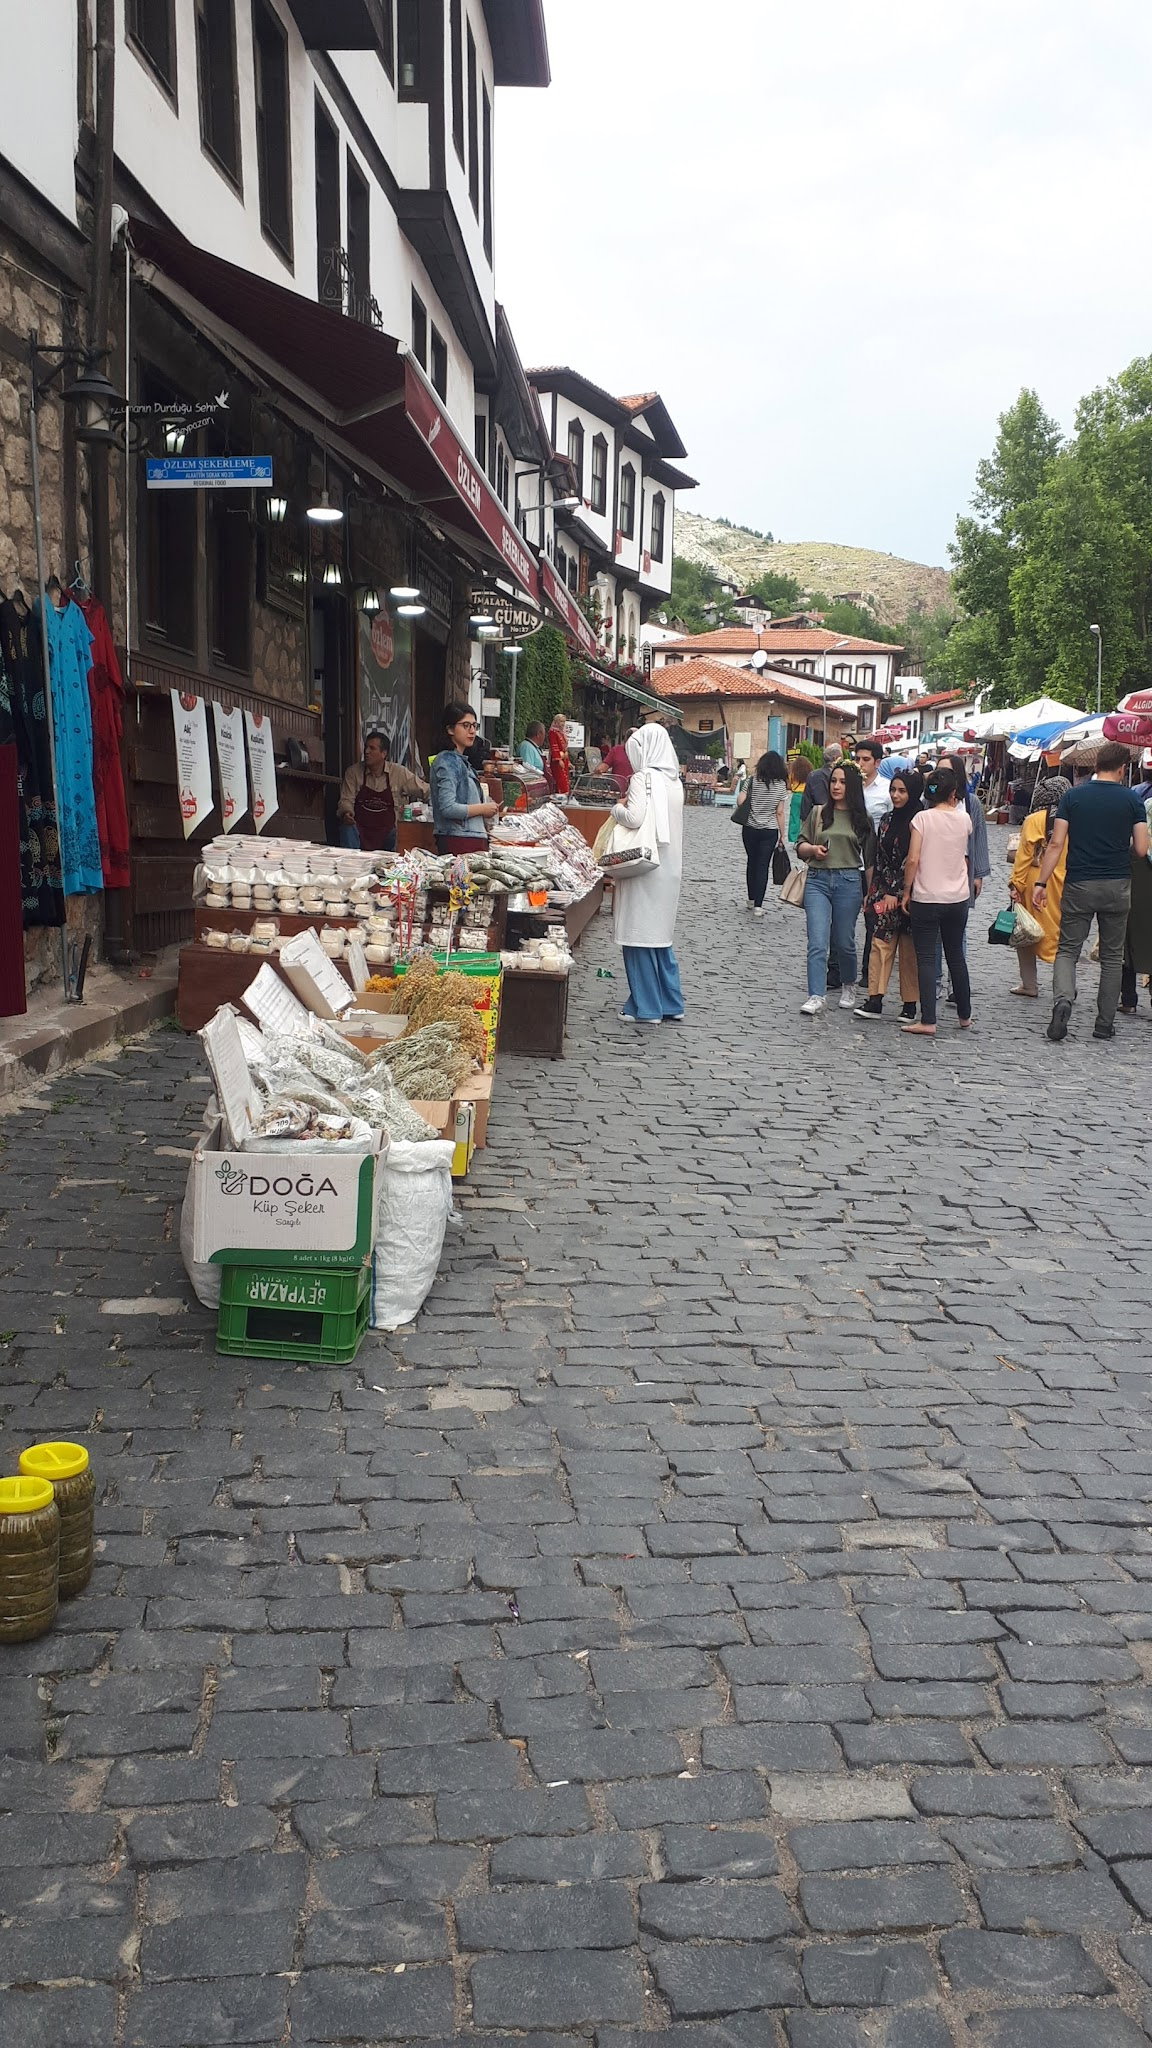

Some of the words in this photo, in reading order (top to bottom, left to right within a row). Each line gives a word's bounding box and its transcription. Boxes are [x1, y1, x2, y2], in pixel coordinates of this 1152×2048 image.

[154, 402, 192, 415] Durduğu
[163, 459, 196, 469] ÖZLEM
[198, 459, 255, 472] ŞEKERLEME
[457, 448, 481, 513] ÖZLEM
[501, 525, 530, 584] ŞEKERLEME
[1117, 719, 1140, 733] Golf
[1025, 737, 1042, 746] Golf
[249, 1173, 339, 1197] DOĞA
[253, 1199, 279, 1216] Küp
[284, 1200, 326, 1217] Şeker
[275, 1218, 302, 1228] Sargılı
[293, 1254, 298, 1262] 8
[298, 1254, 313, 1262] adet
